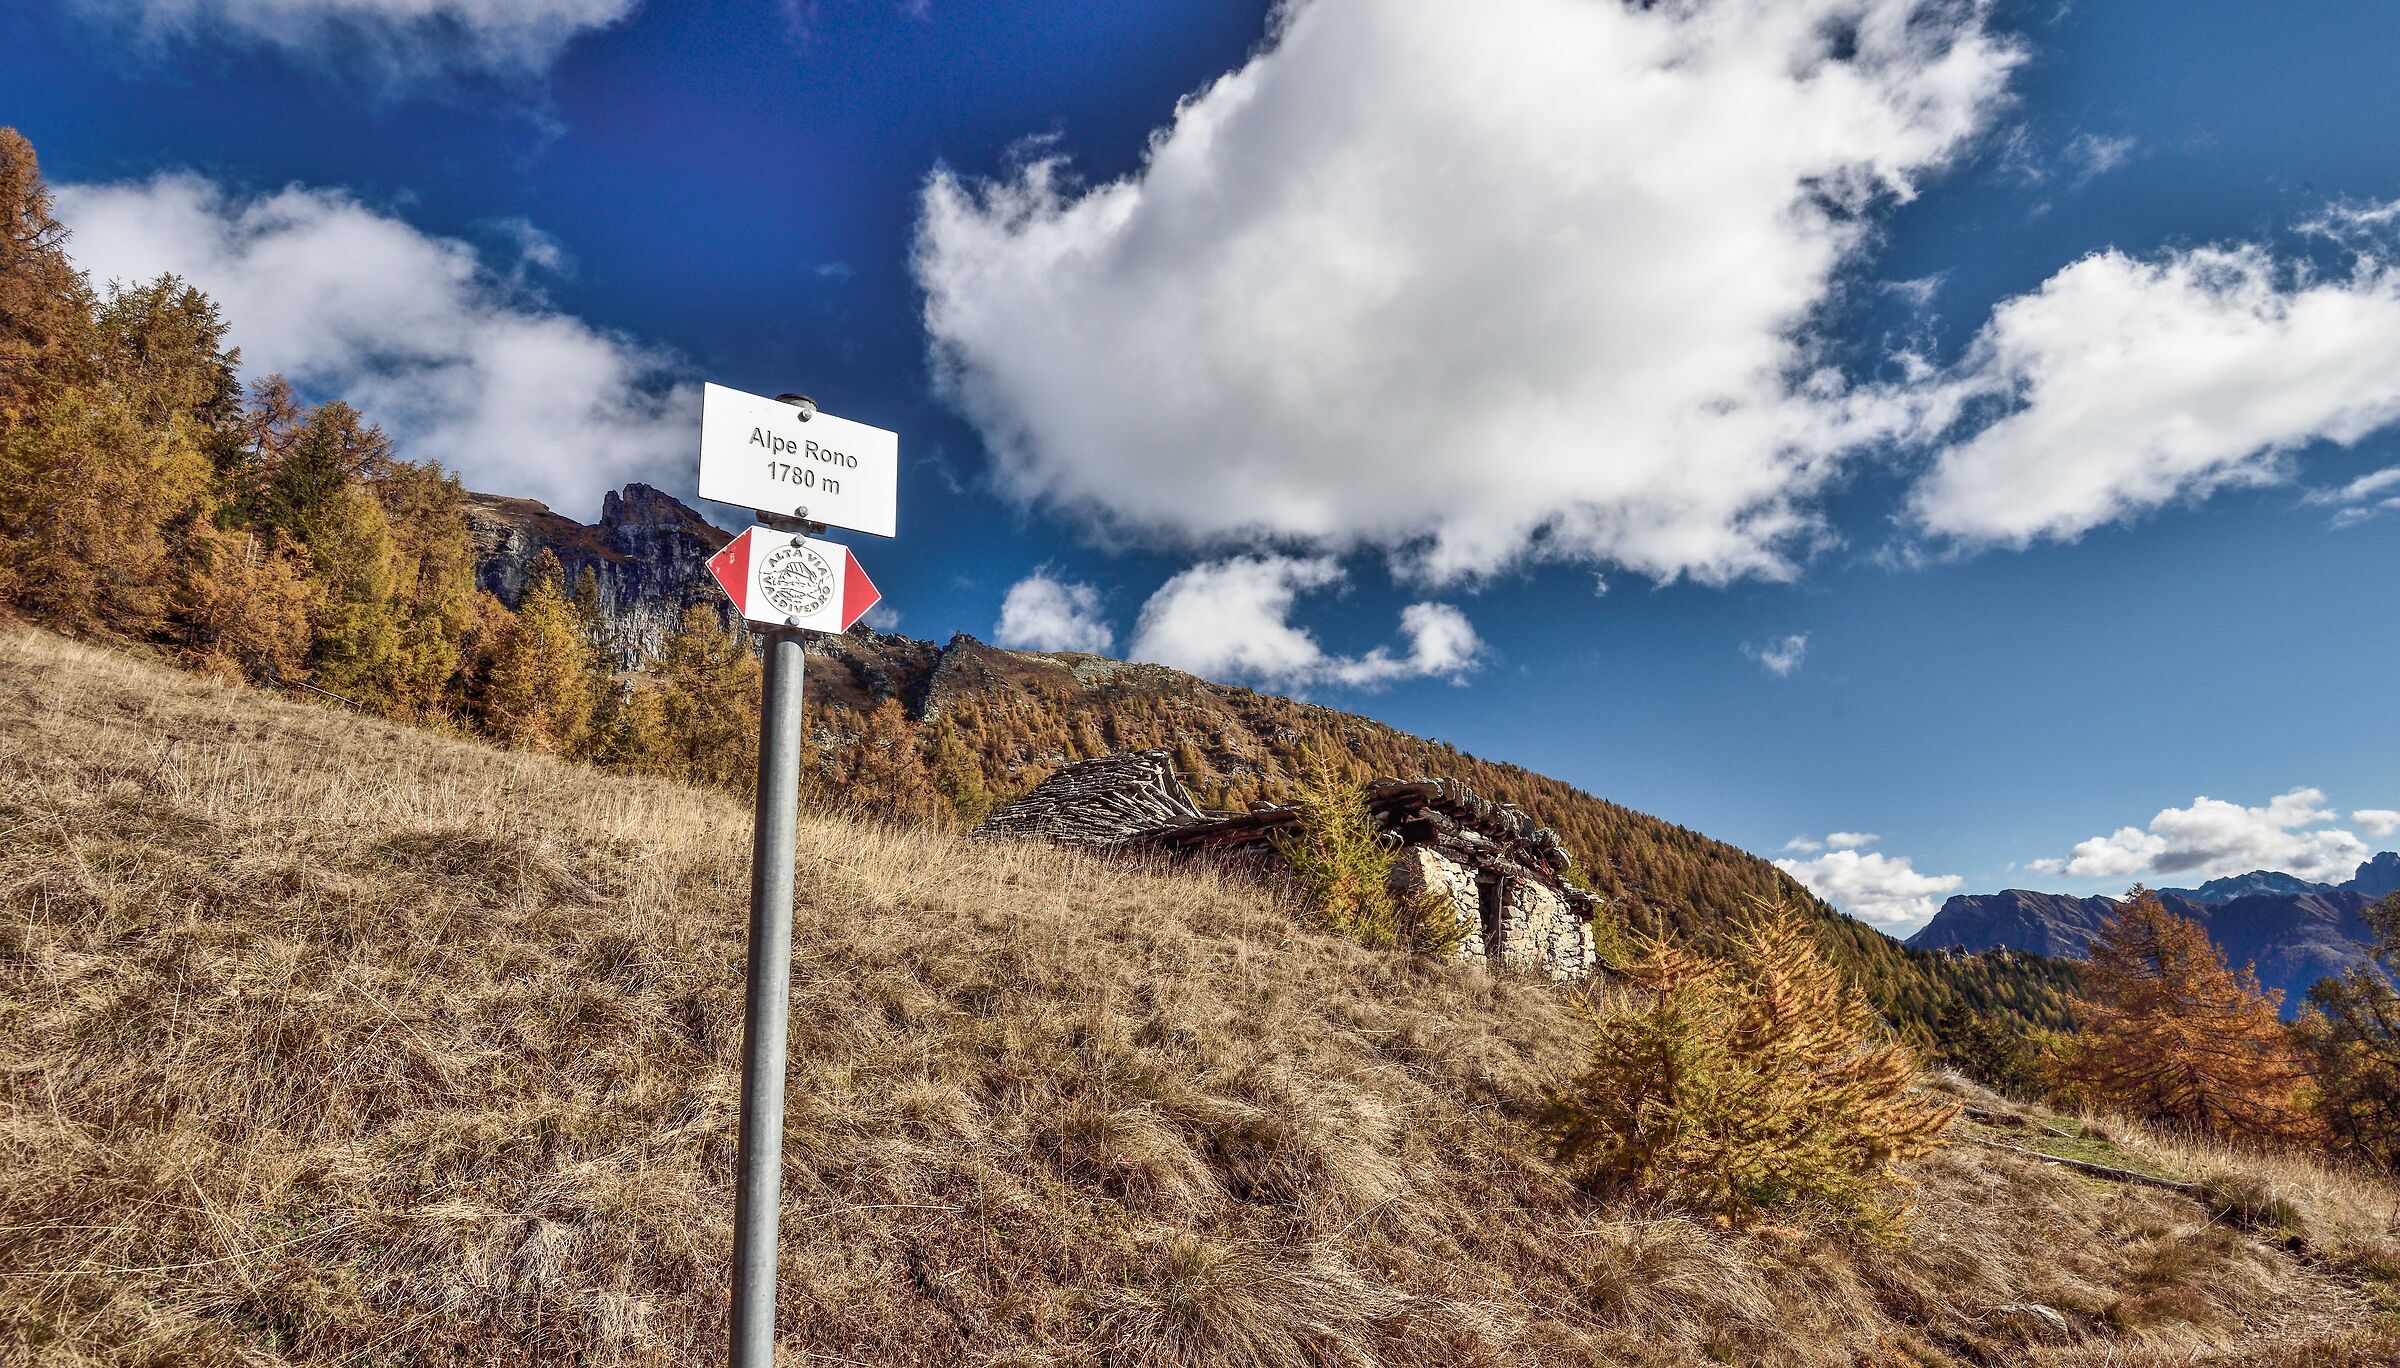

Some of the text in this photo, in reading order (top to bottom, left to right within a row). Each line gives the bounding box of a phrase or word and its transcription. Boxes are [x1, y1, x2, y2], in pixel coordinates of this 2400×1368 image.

[749, 427, 858, 470] Alpe Rono
[767, 461, 840, 495] 1780 m
[768, 549, 828, 576] ALTA VIA
